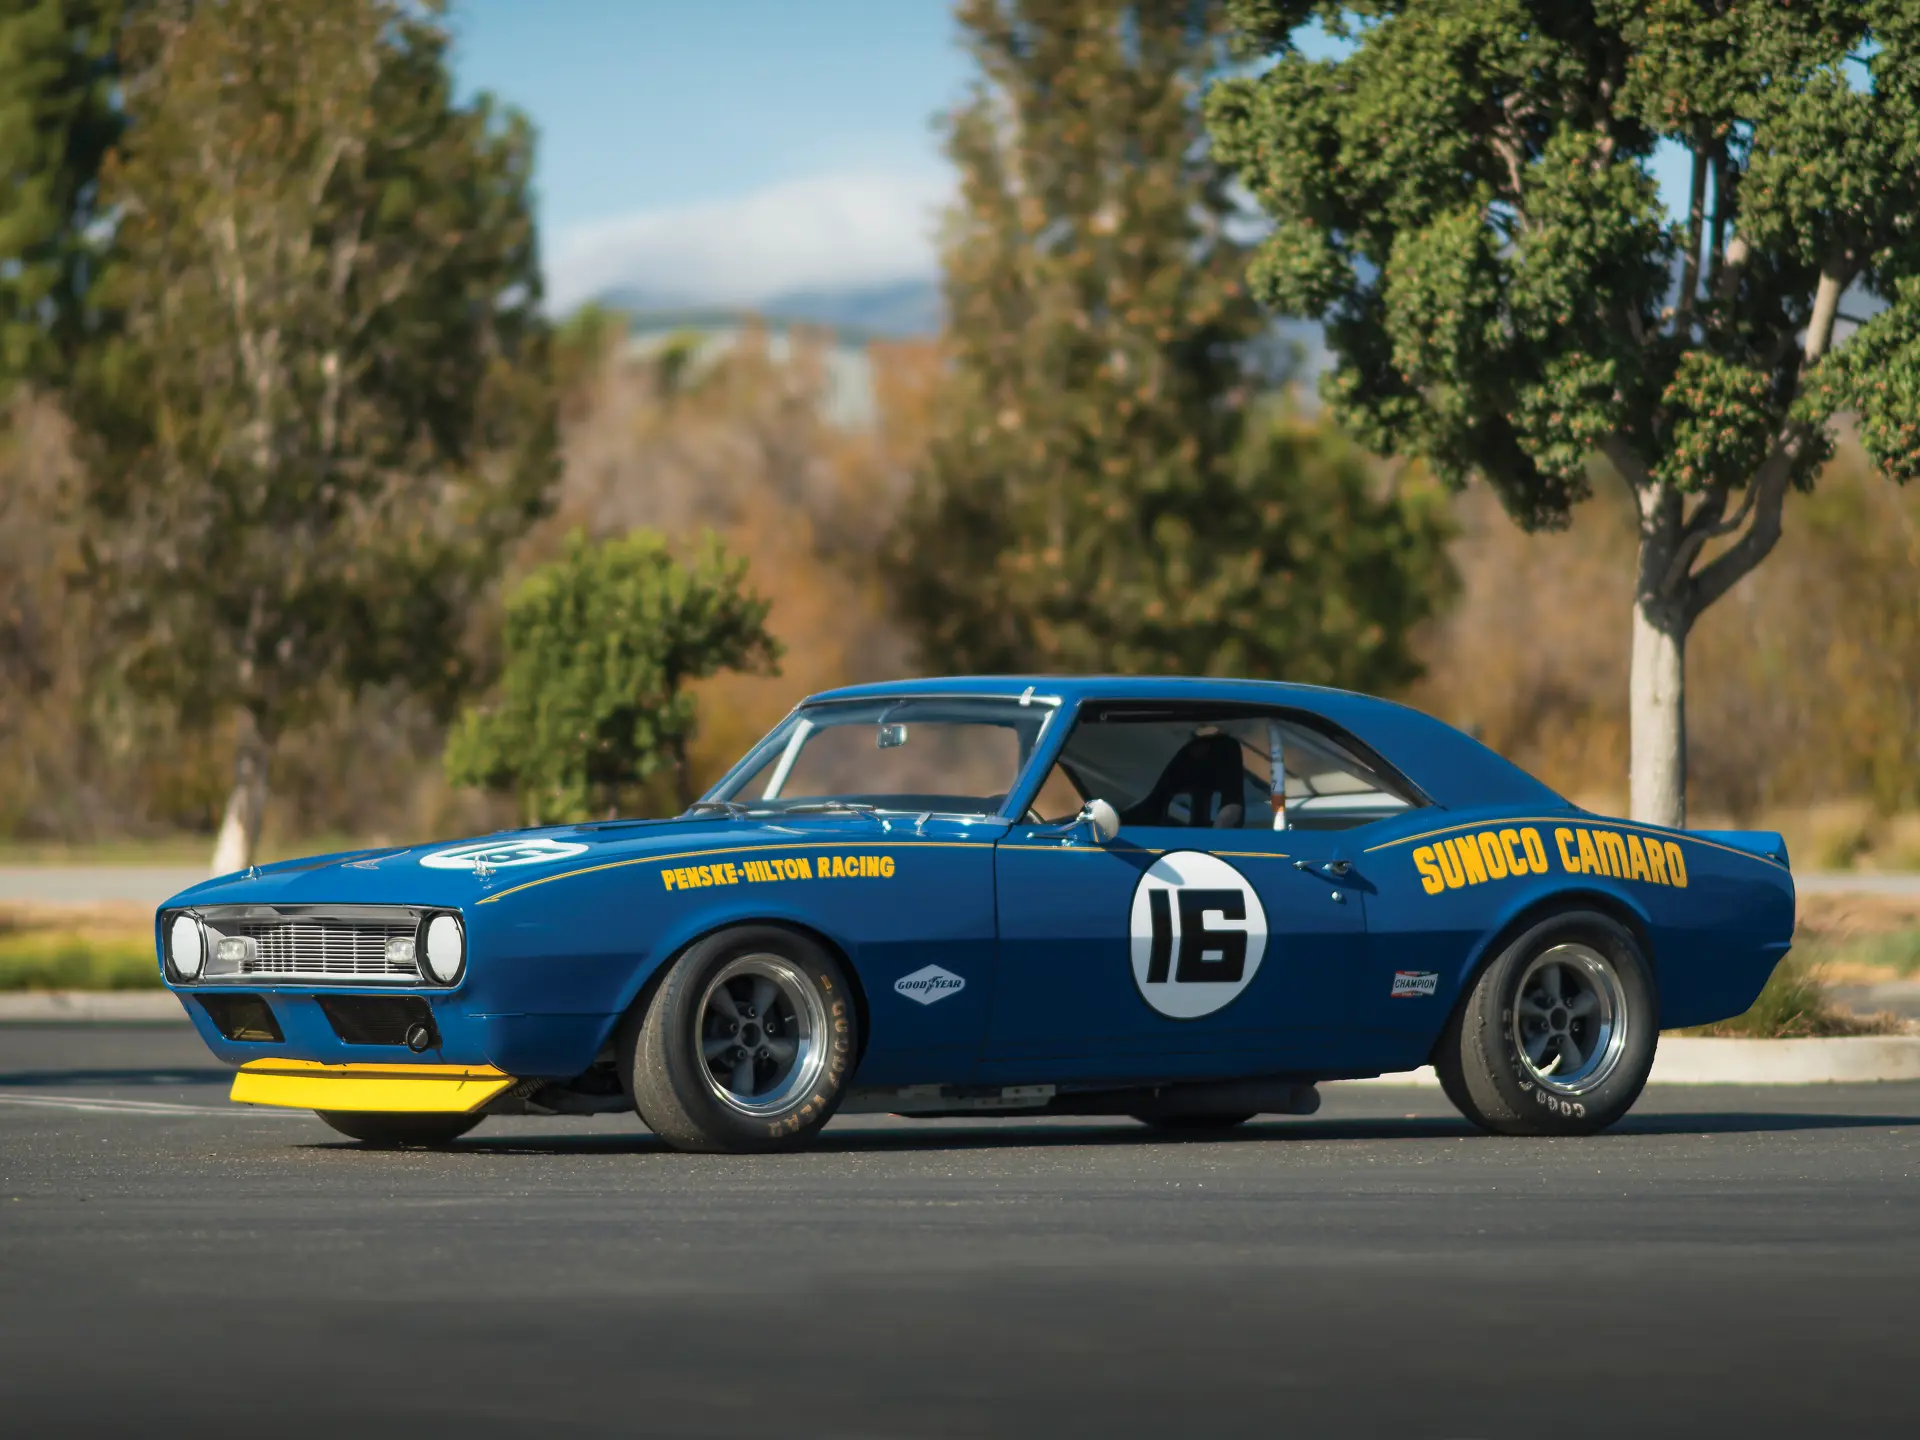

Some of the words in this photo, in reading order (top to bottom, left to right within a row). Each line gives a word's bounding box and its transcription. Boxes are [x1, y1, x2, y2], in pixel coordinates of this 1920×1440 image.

[817, 856, 896, 878] RACING
[1412, 827, 1549, 895] SUNOCO
[1554, 828, 1689, 888] CAMARO
[1146, 889, 1248, 983] 16
[1395, 979, 1436, 989] CHAMPION
